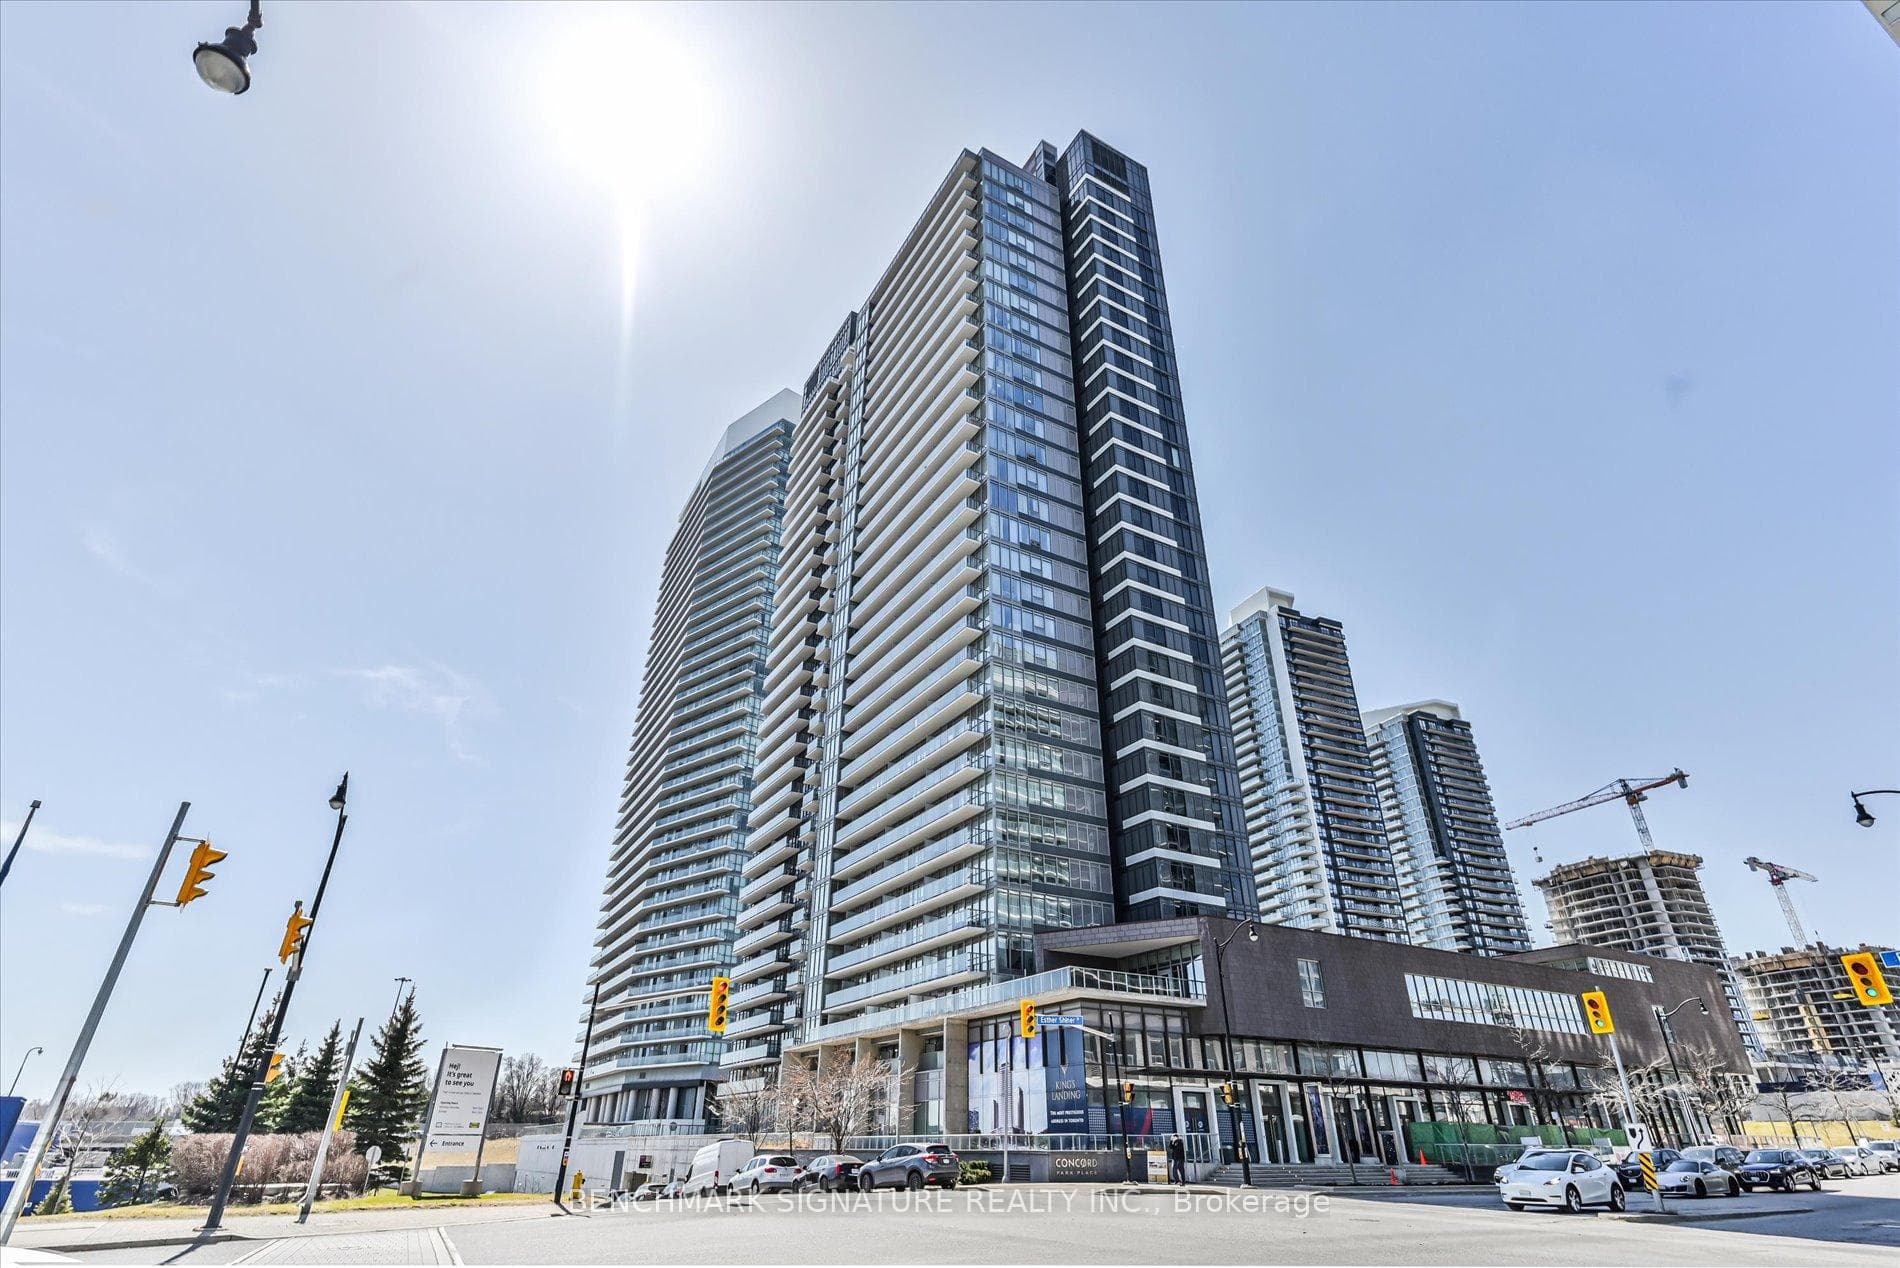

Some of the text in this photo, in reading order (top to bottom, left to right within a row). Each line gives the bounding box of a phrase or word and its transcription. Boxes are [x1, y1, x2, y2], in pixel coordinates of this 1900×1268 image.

[1055, 1080, 1076, 1090] KINGS
[1051, 1090, 1081, 1101] LANDING
[1055, 1158, 1098, 1168] CONCORD
